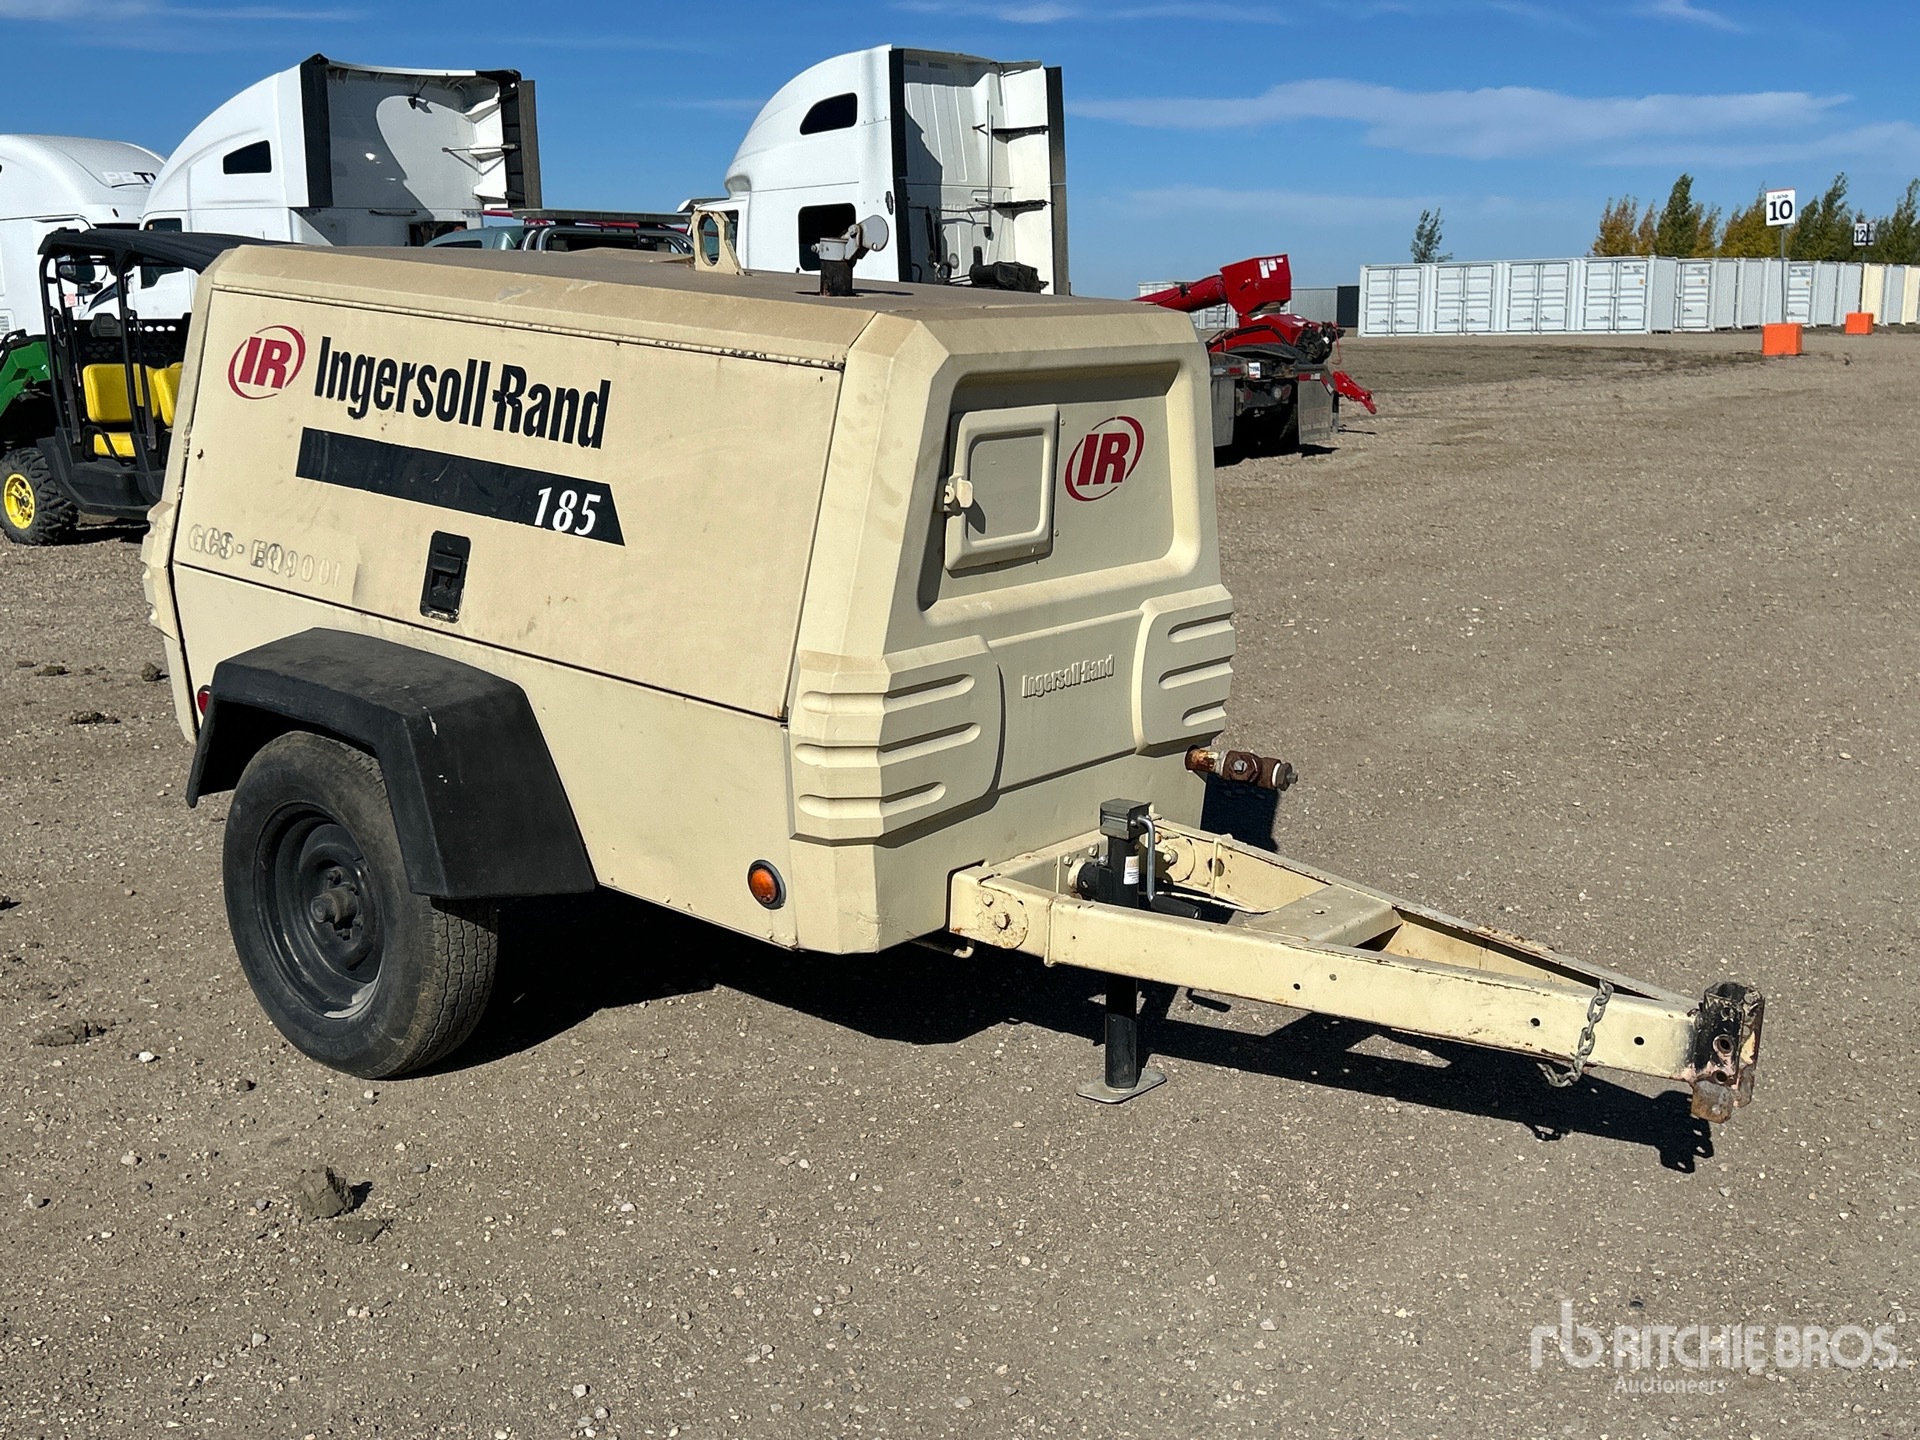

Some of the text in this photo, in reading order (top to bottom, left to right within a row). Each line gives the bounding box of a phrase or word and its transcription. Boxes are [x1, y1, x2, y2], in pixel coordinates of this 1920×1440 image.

[1769, 200, 1793, 221] 10
[238, 336, 293, 390] IR
[314, 336, 612, 449] Ingersoll-Rand
[1077, 432, 1132, 487] IR
[533, 487, 601, 536] 185
[1022, 654, 1115, 698] Ingersoll-Rand
